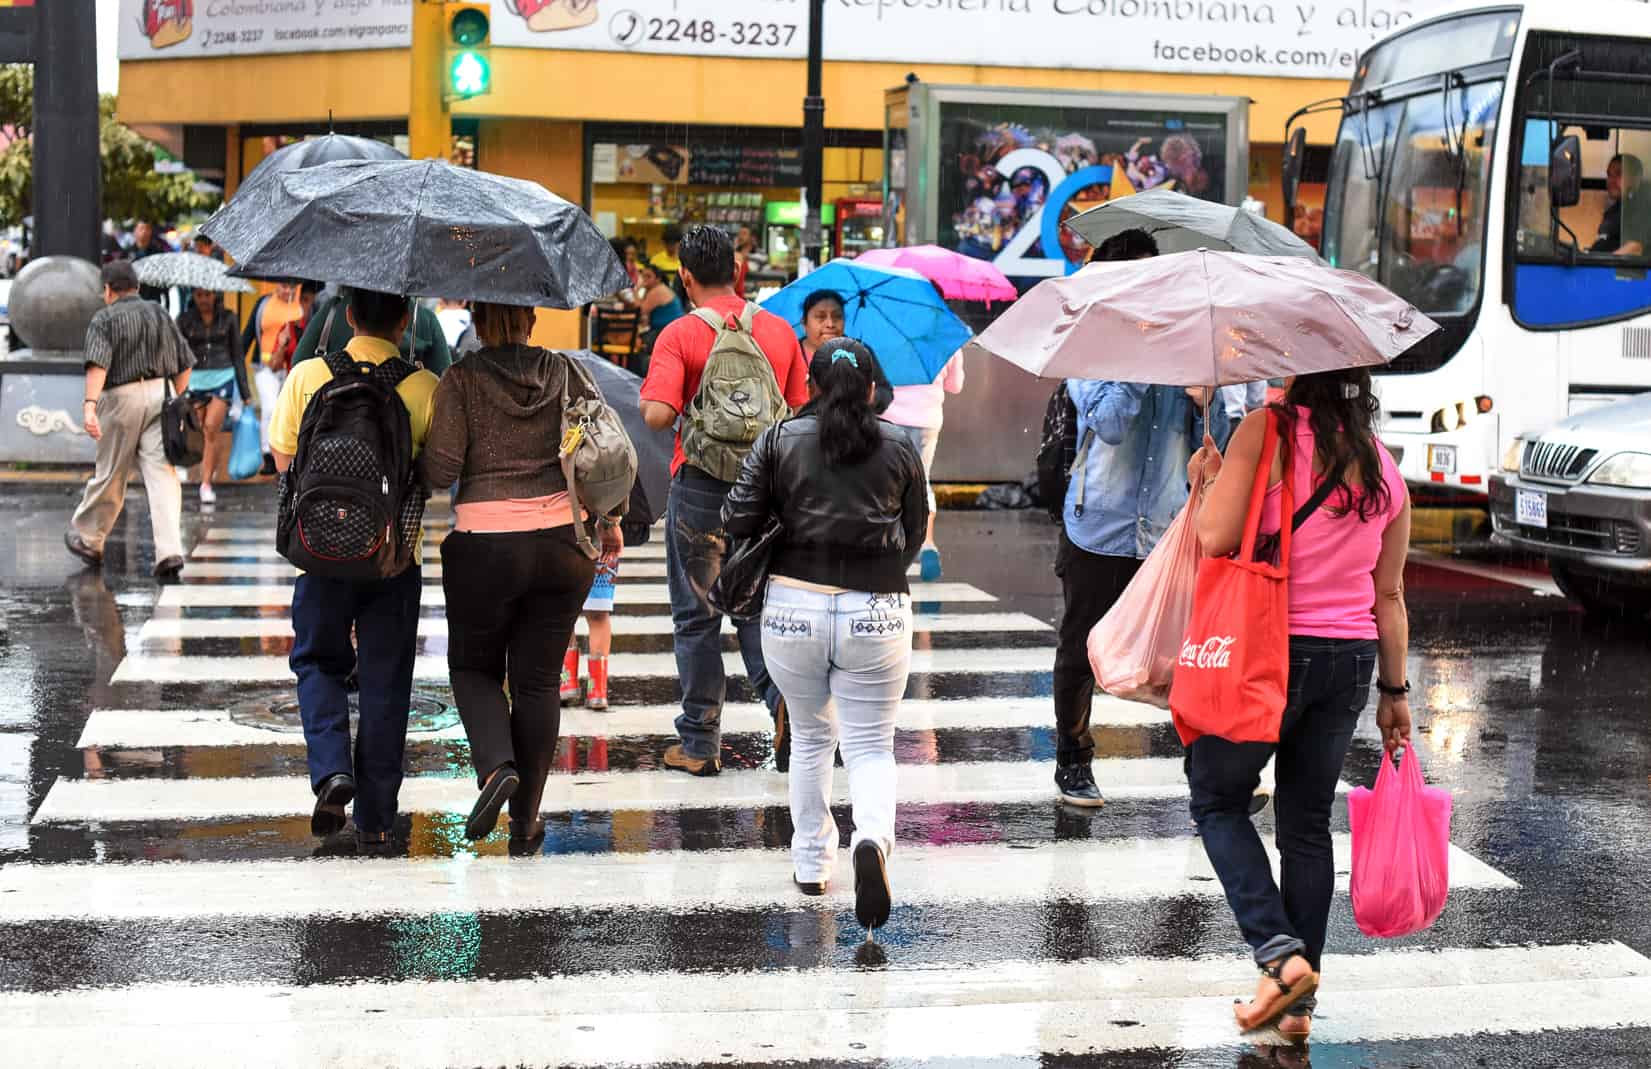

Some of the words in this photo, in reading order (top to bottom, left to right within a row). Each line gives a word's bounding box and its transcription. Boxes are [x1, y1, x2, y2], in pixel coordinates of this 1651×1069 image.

[647, 17, 798, 47] 2248-3237
[1296, 4, 1316, 36] y
[213, 28, 265, 44] 2248-3237
[1178, 635, 1237, 669] Coca-Cola
